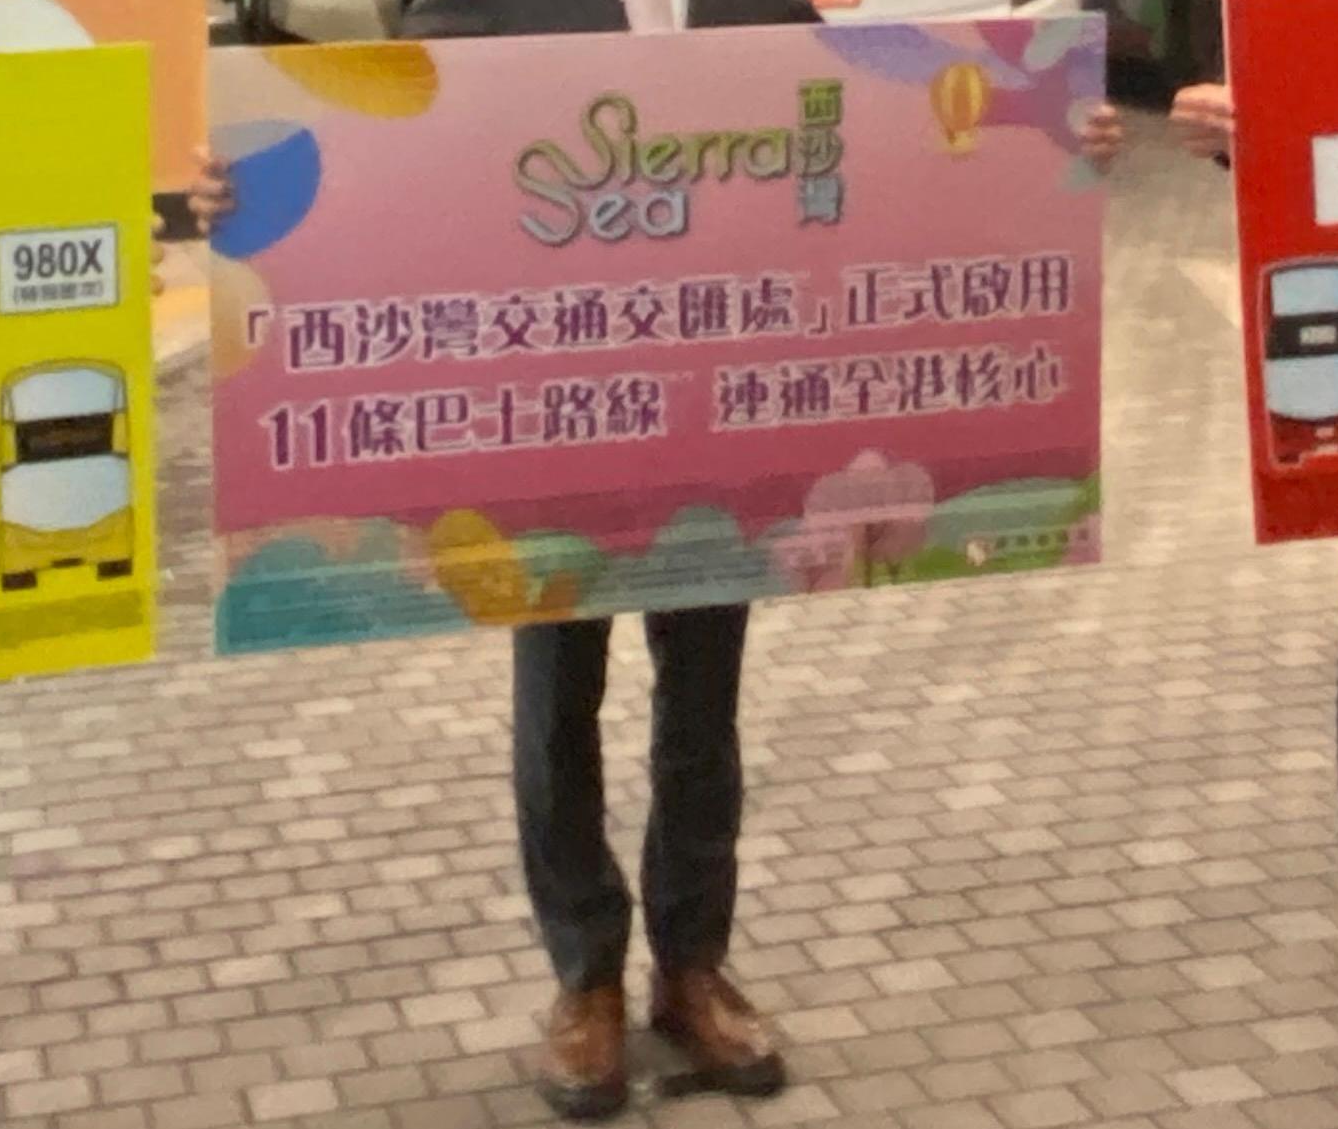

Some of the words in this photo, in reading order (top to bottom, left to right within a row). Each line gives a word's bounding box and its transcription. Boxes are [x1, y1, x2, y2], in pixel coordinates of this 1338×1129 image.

[565, 87, 792, 192] Sierra
[13, 238, 104, 282] 980X
[267, 375, 666, 470] 11條巴士路線
